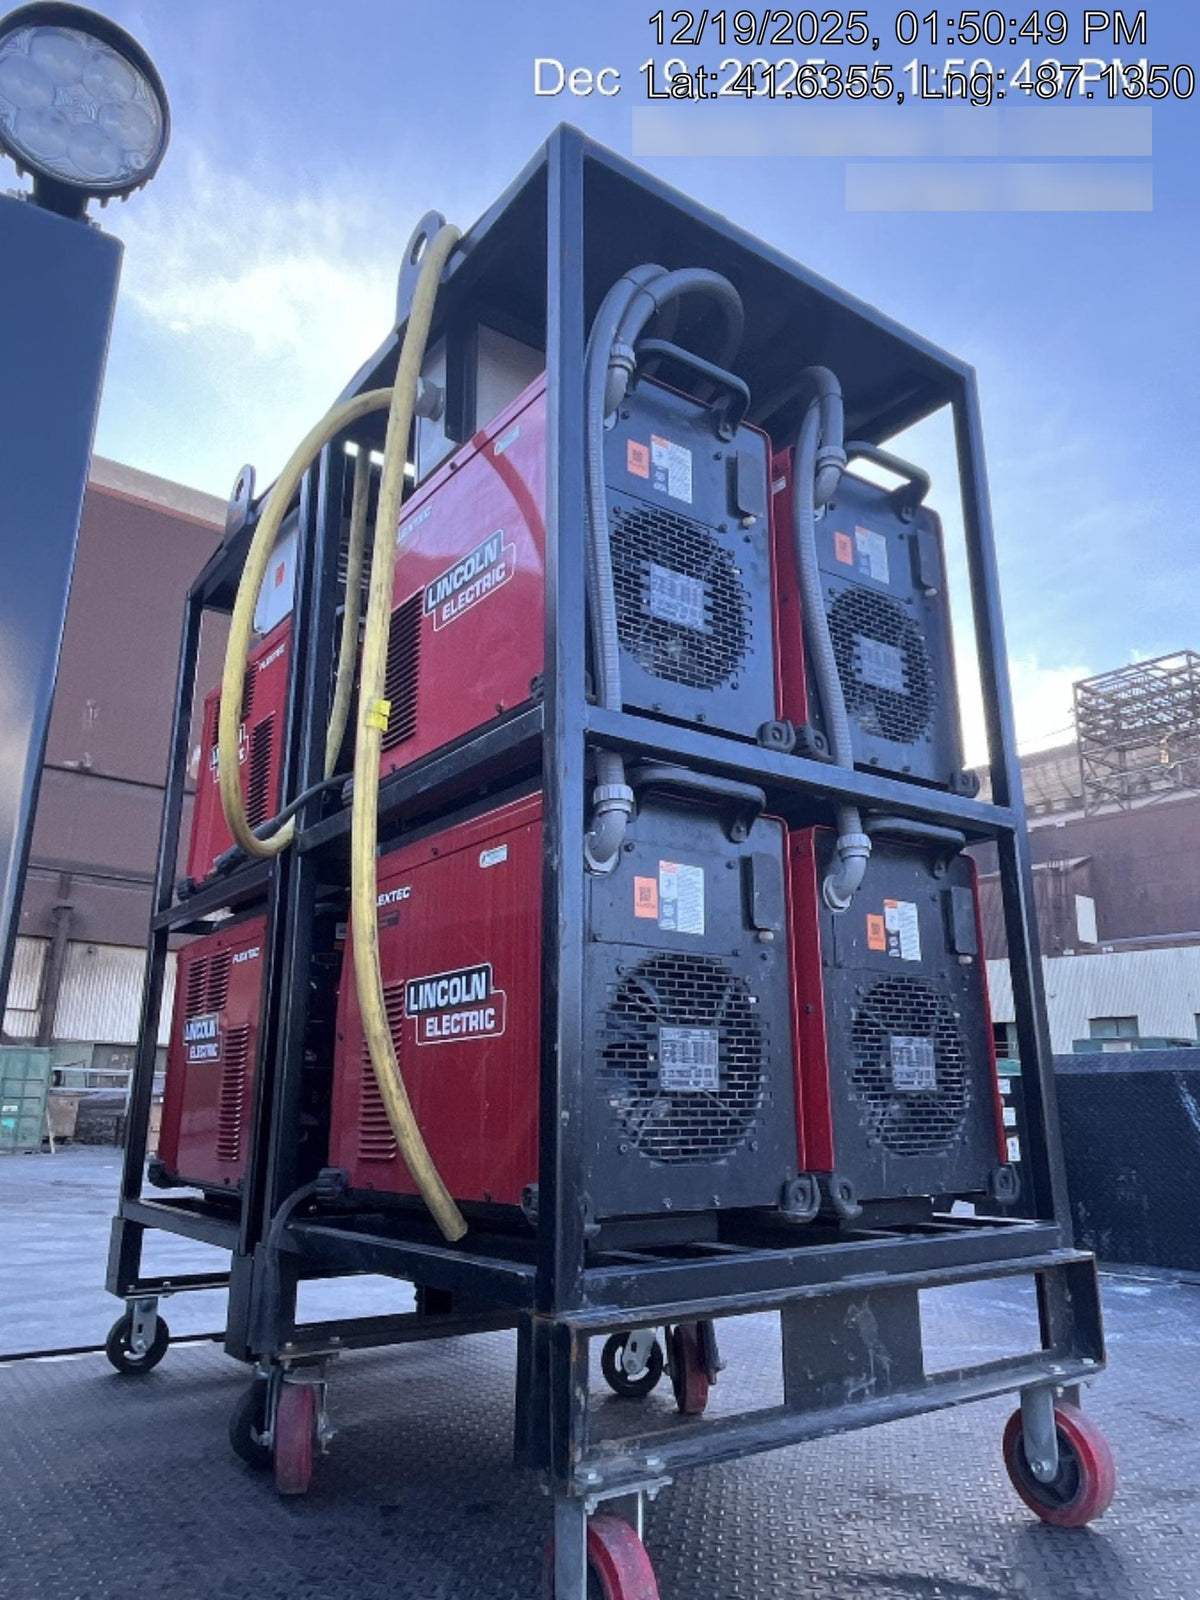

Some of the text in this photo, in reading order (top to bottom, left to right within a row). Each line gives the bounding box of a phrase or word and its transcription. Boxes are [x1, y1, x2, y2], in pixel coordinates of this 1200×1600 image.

[427, 535, 500, 611] LINCOLN
[441, 562, 506, 622] ELECTRIC
[410, 971, 486, 1011] LINCOLN
[425, 1007, 496, 1038] ELECTRIC
